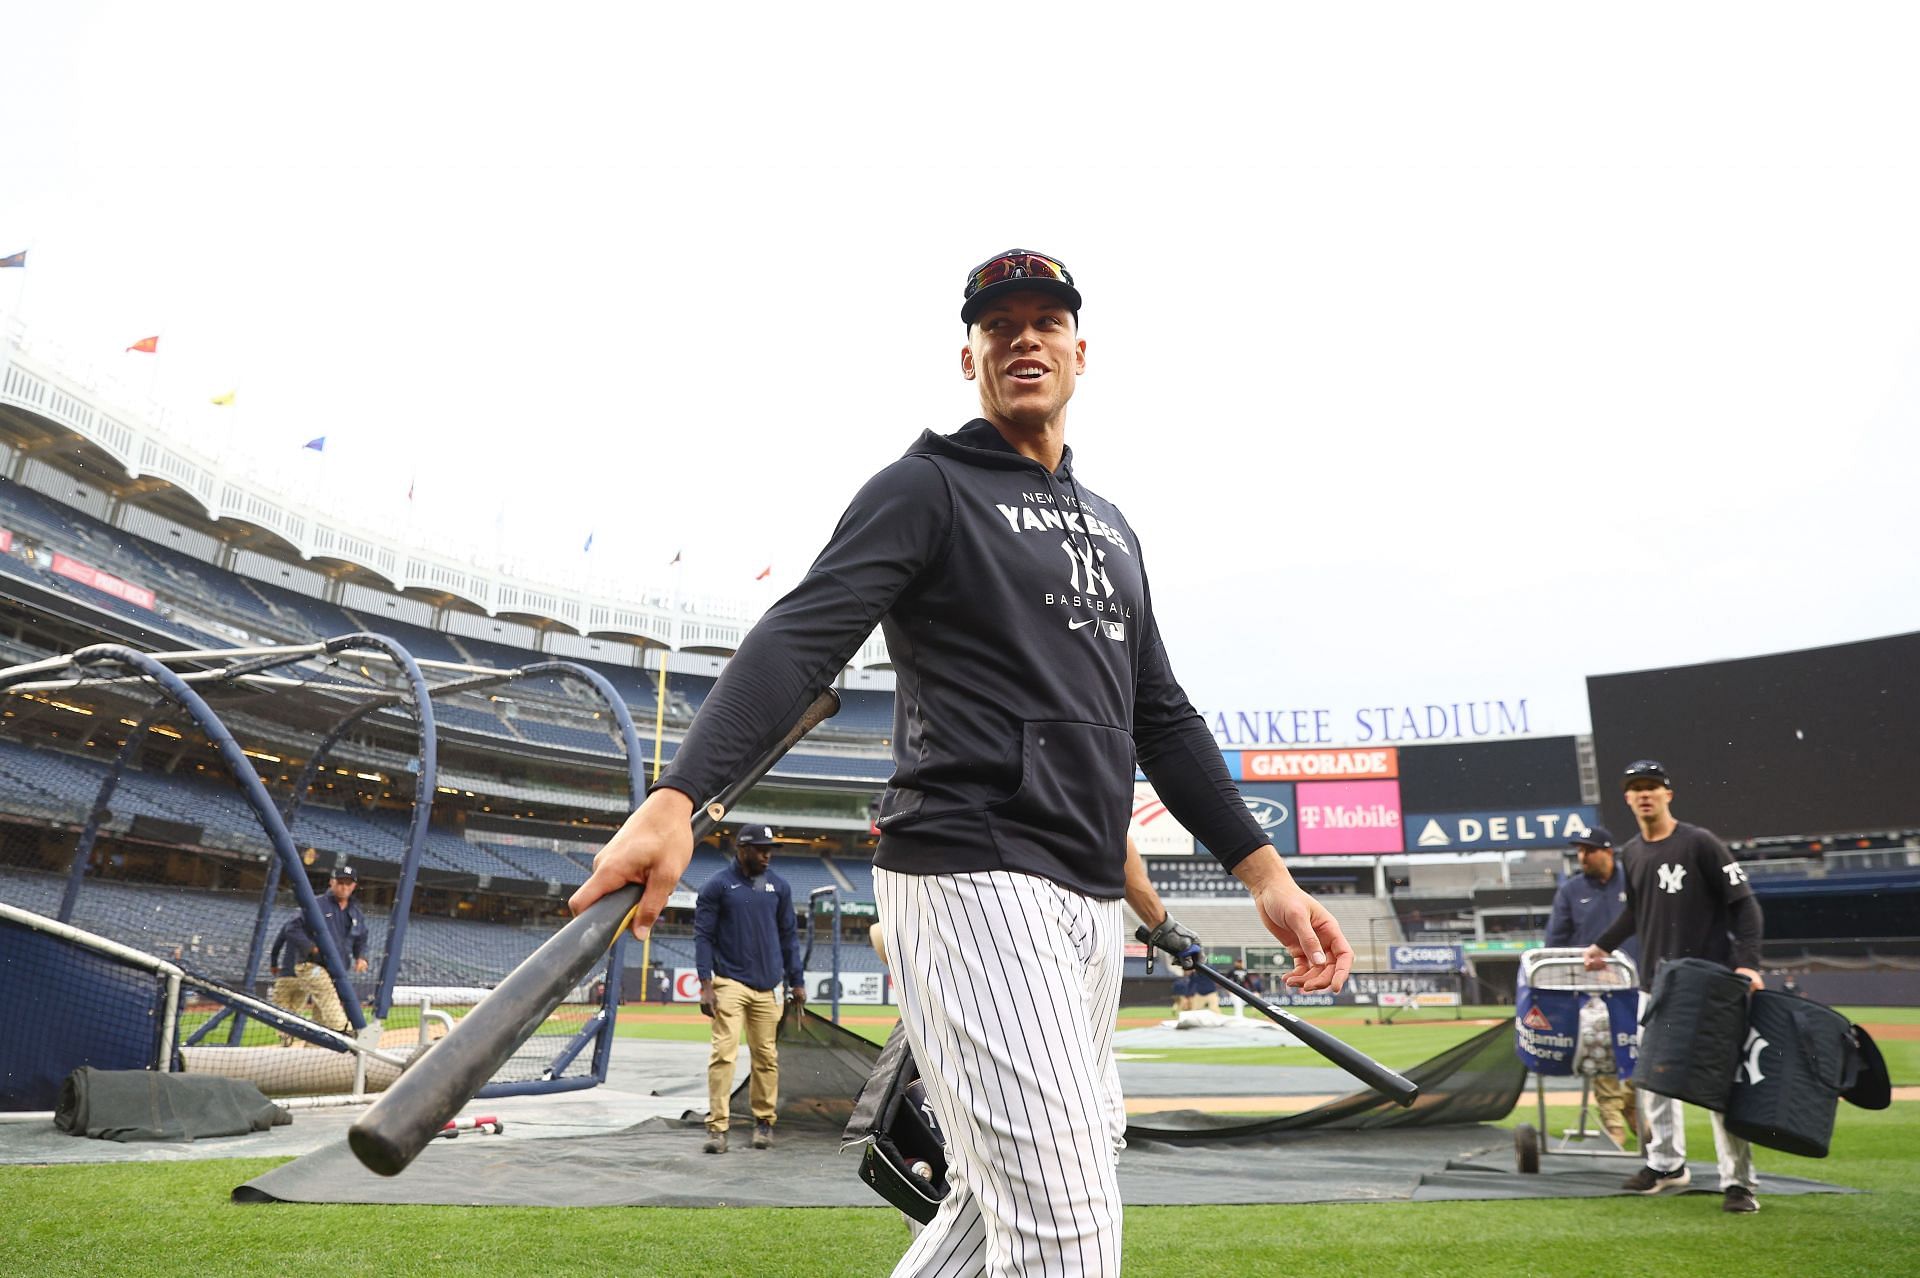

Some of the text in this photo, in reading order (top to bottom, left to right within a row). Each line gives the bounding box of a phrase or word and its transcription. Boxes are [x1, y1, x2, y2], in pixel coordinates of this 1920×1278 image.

[996, 503, 1131, 556] YANKEES
[1045, 593, 1131, 619] BASEBALL
[1355, 698, 1531, 743] STADIUM
[1251, 751, 1387, 776] GATORADE
[1323, 804, 1400, 830] Mobile
[1458, 812, 1586, 843] DELTA
[1657, 863, 1688, 895] NY
